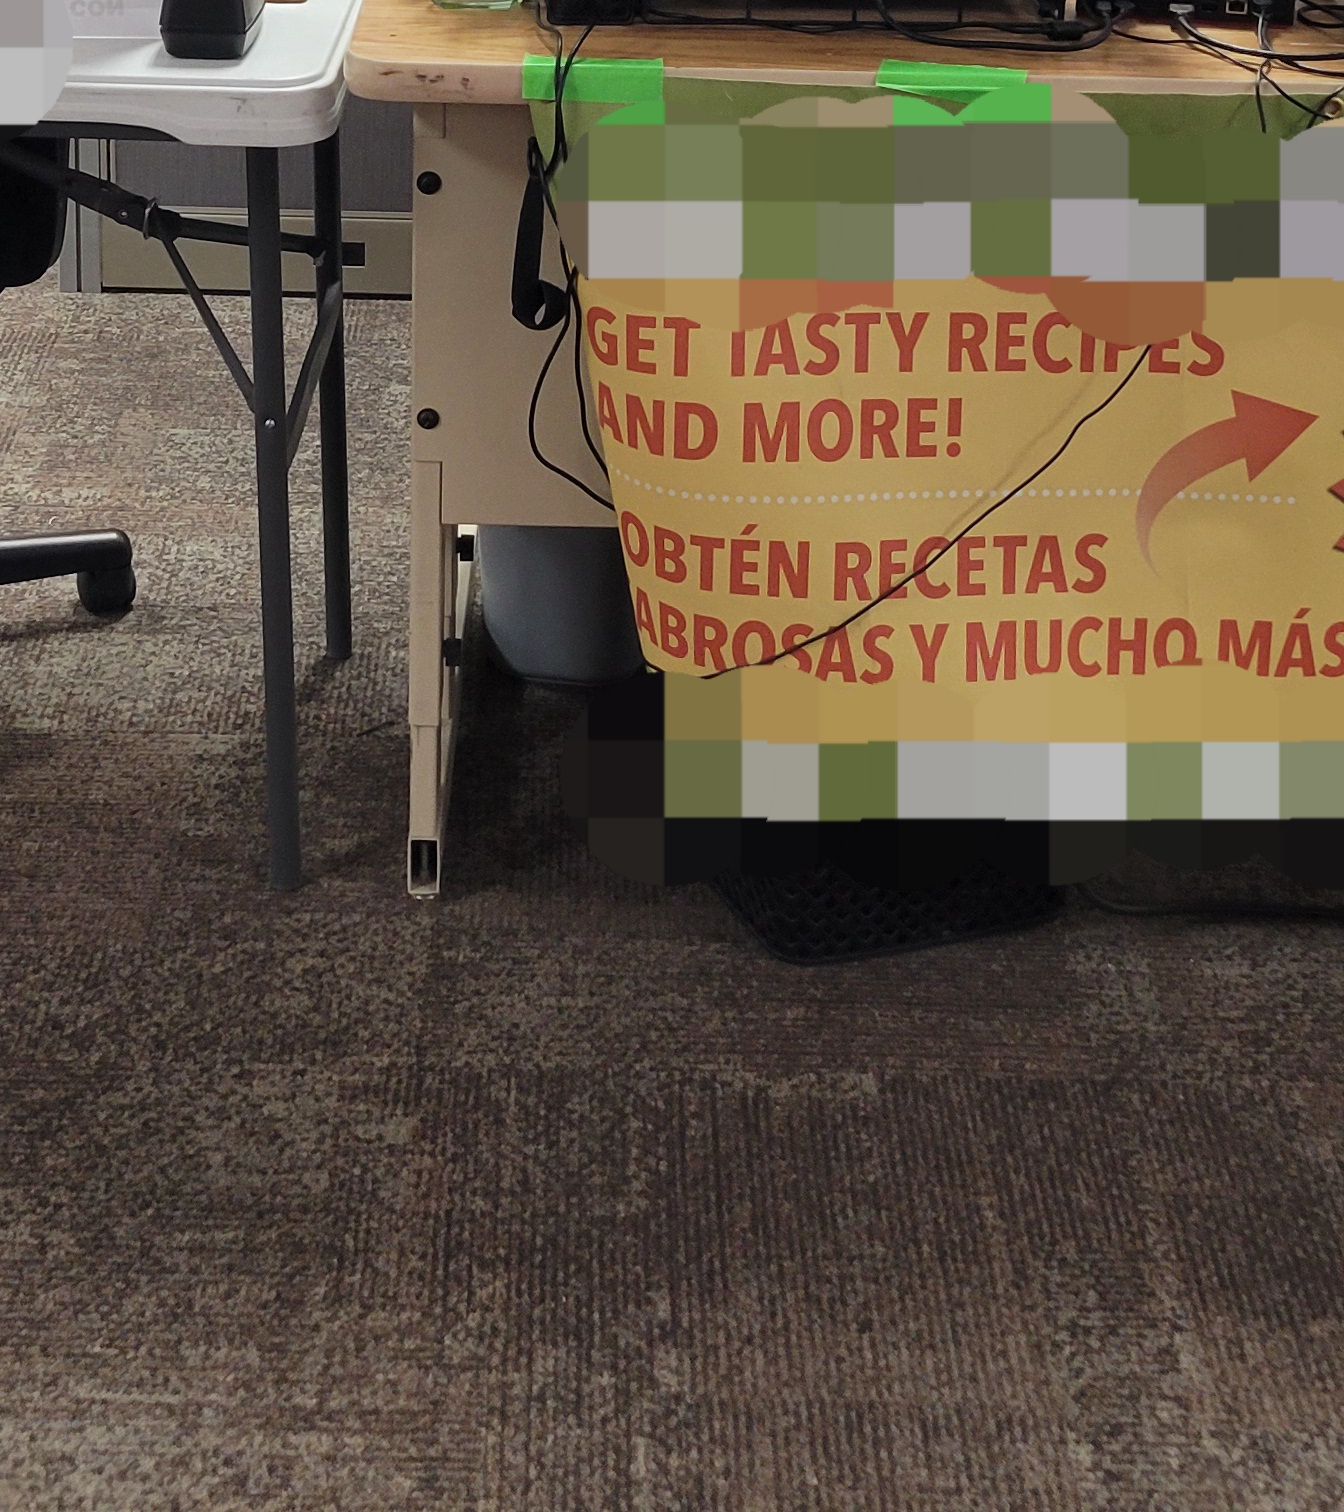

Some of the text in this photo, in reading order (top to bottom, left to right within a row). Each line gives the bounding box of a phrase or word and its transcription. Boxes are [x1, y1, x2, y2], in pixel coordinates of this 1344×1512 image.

[587, 306, 701, 377] GET
[731, 312, 930, 377] TASTY
[598, 381, 962, 463] AND MORE!
[620, 510, 1109, 601] OBTÉN RECETAS
[636, 586, 895, 685] ABROSAS
[909, 623, 949, 684] Y
[966, 616, 1203, 682] MUCHO
